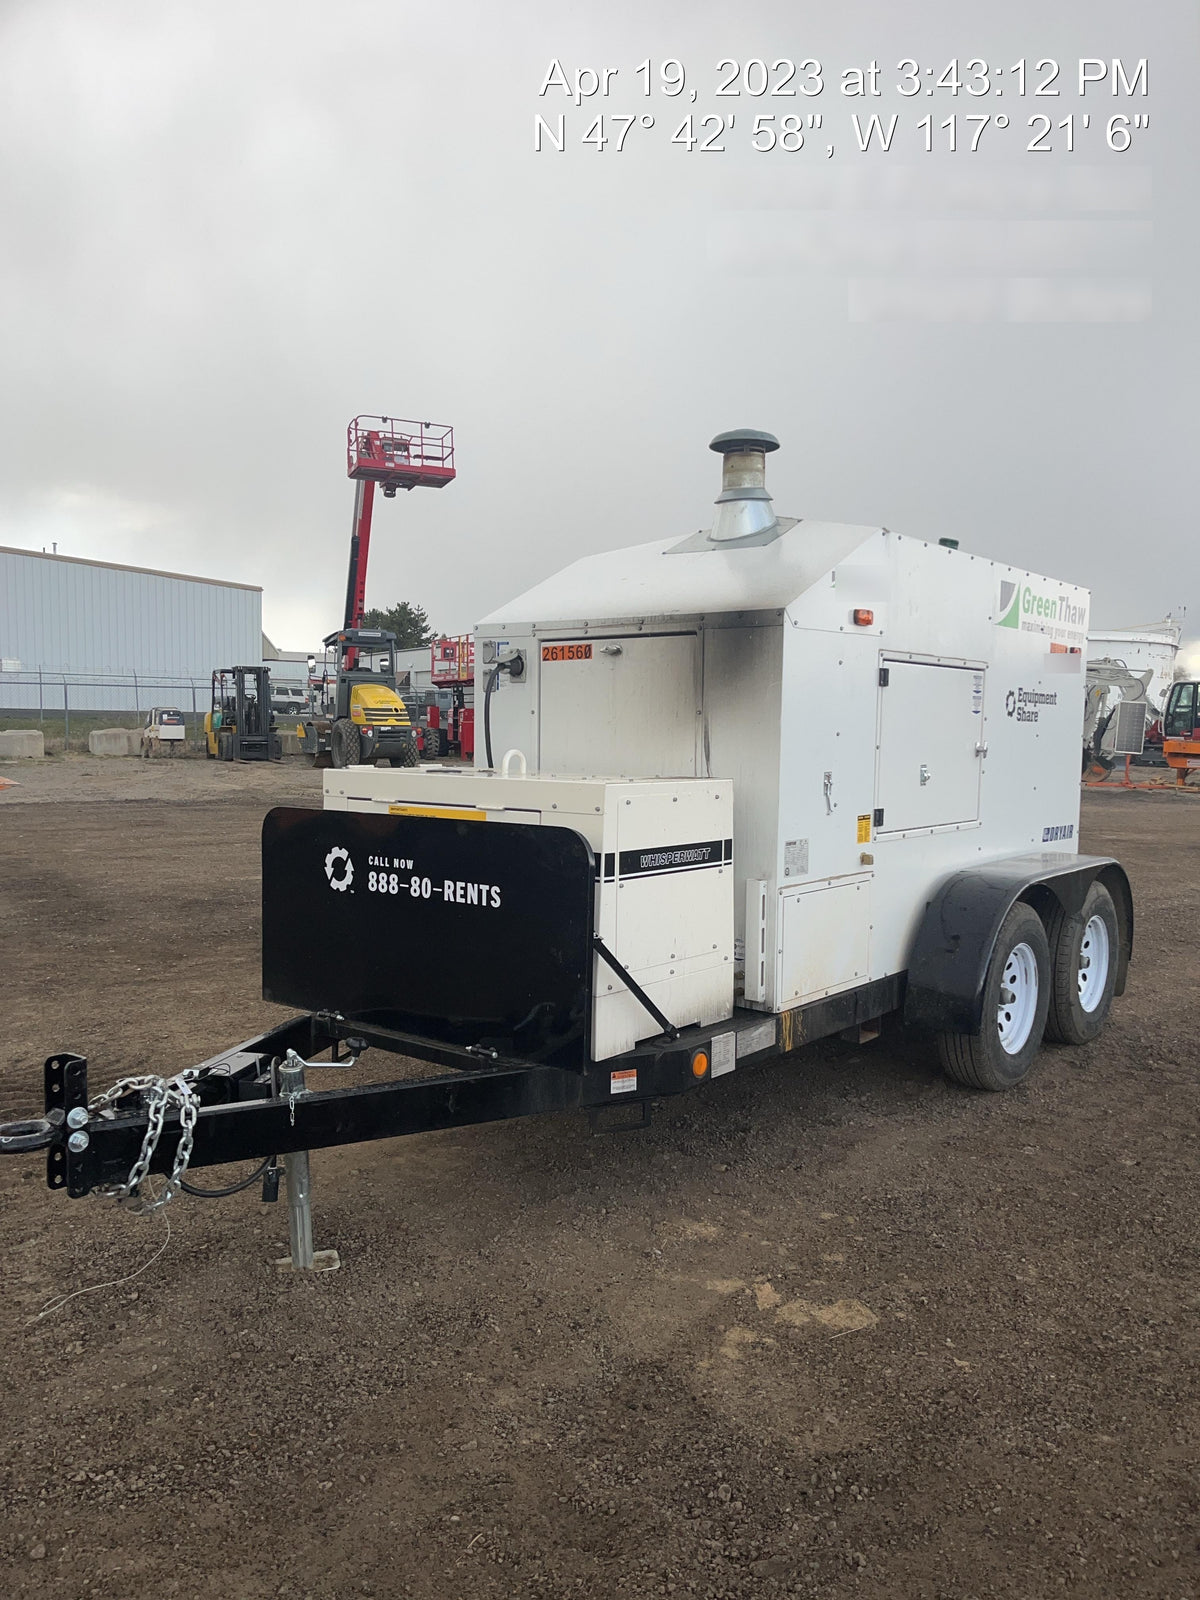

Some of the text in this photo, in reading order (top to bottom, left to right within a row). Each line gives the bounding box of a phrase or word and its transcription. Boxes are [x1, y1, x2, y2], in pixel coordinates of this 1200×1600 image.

[542, 645, 592, 661] 261560
[1017, 687, 1057, 707] Equipment
[1016, 706, 1039, 722] Share
[368, 855, 414, 870] CALL NOW
[640, 847, 711, 868] WHISPERWATT
[368, 870, 501, 909] 888-80-RENTS
